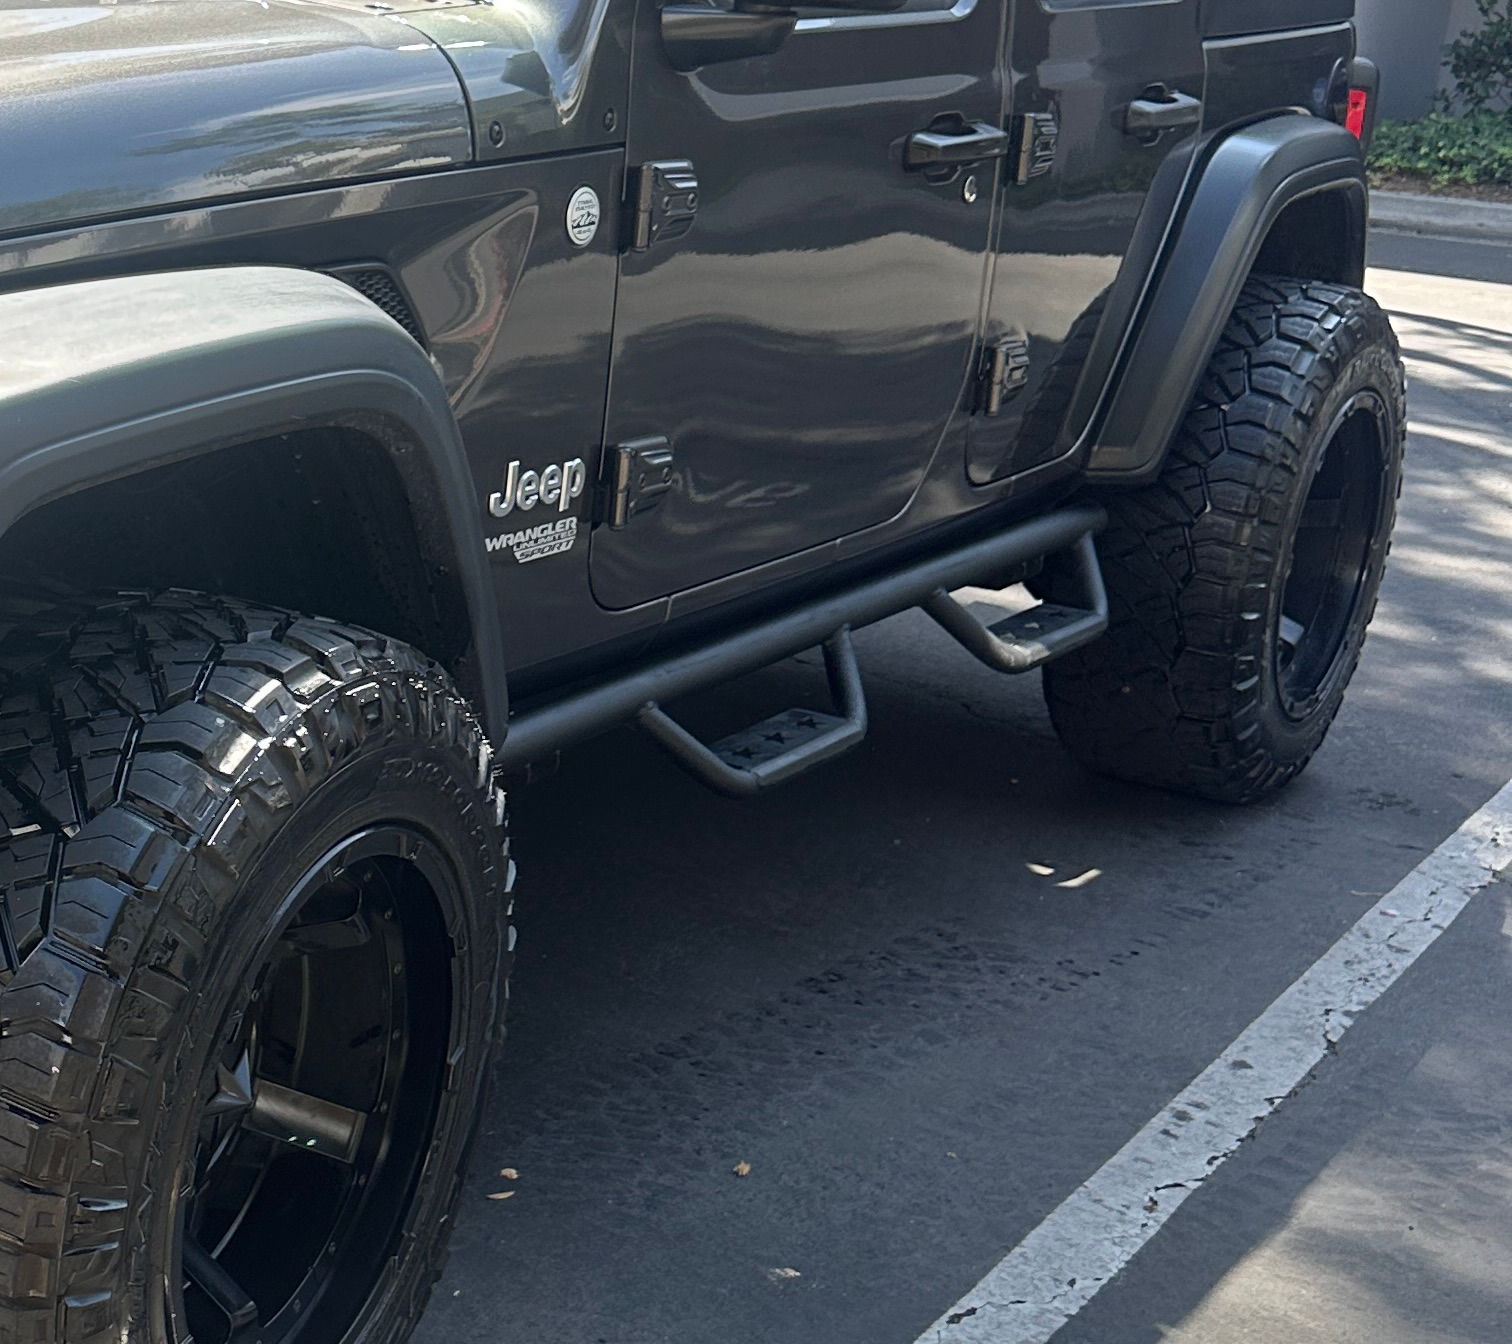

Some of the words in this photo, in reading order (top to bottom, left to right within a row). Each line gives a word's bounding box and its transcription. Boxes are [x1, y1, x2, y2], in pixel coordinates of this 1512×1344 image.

[489, 457, 586, 517] Jeep
[485, 516, 577, 552] WRANGLER
[513, 529, 577, 552] UNLIMITED
